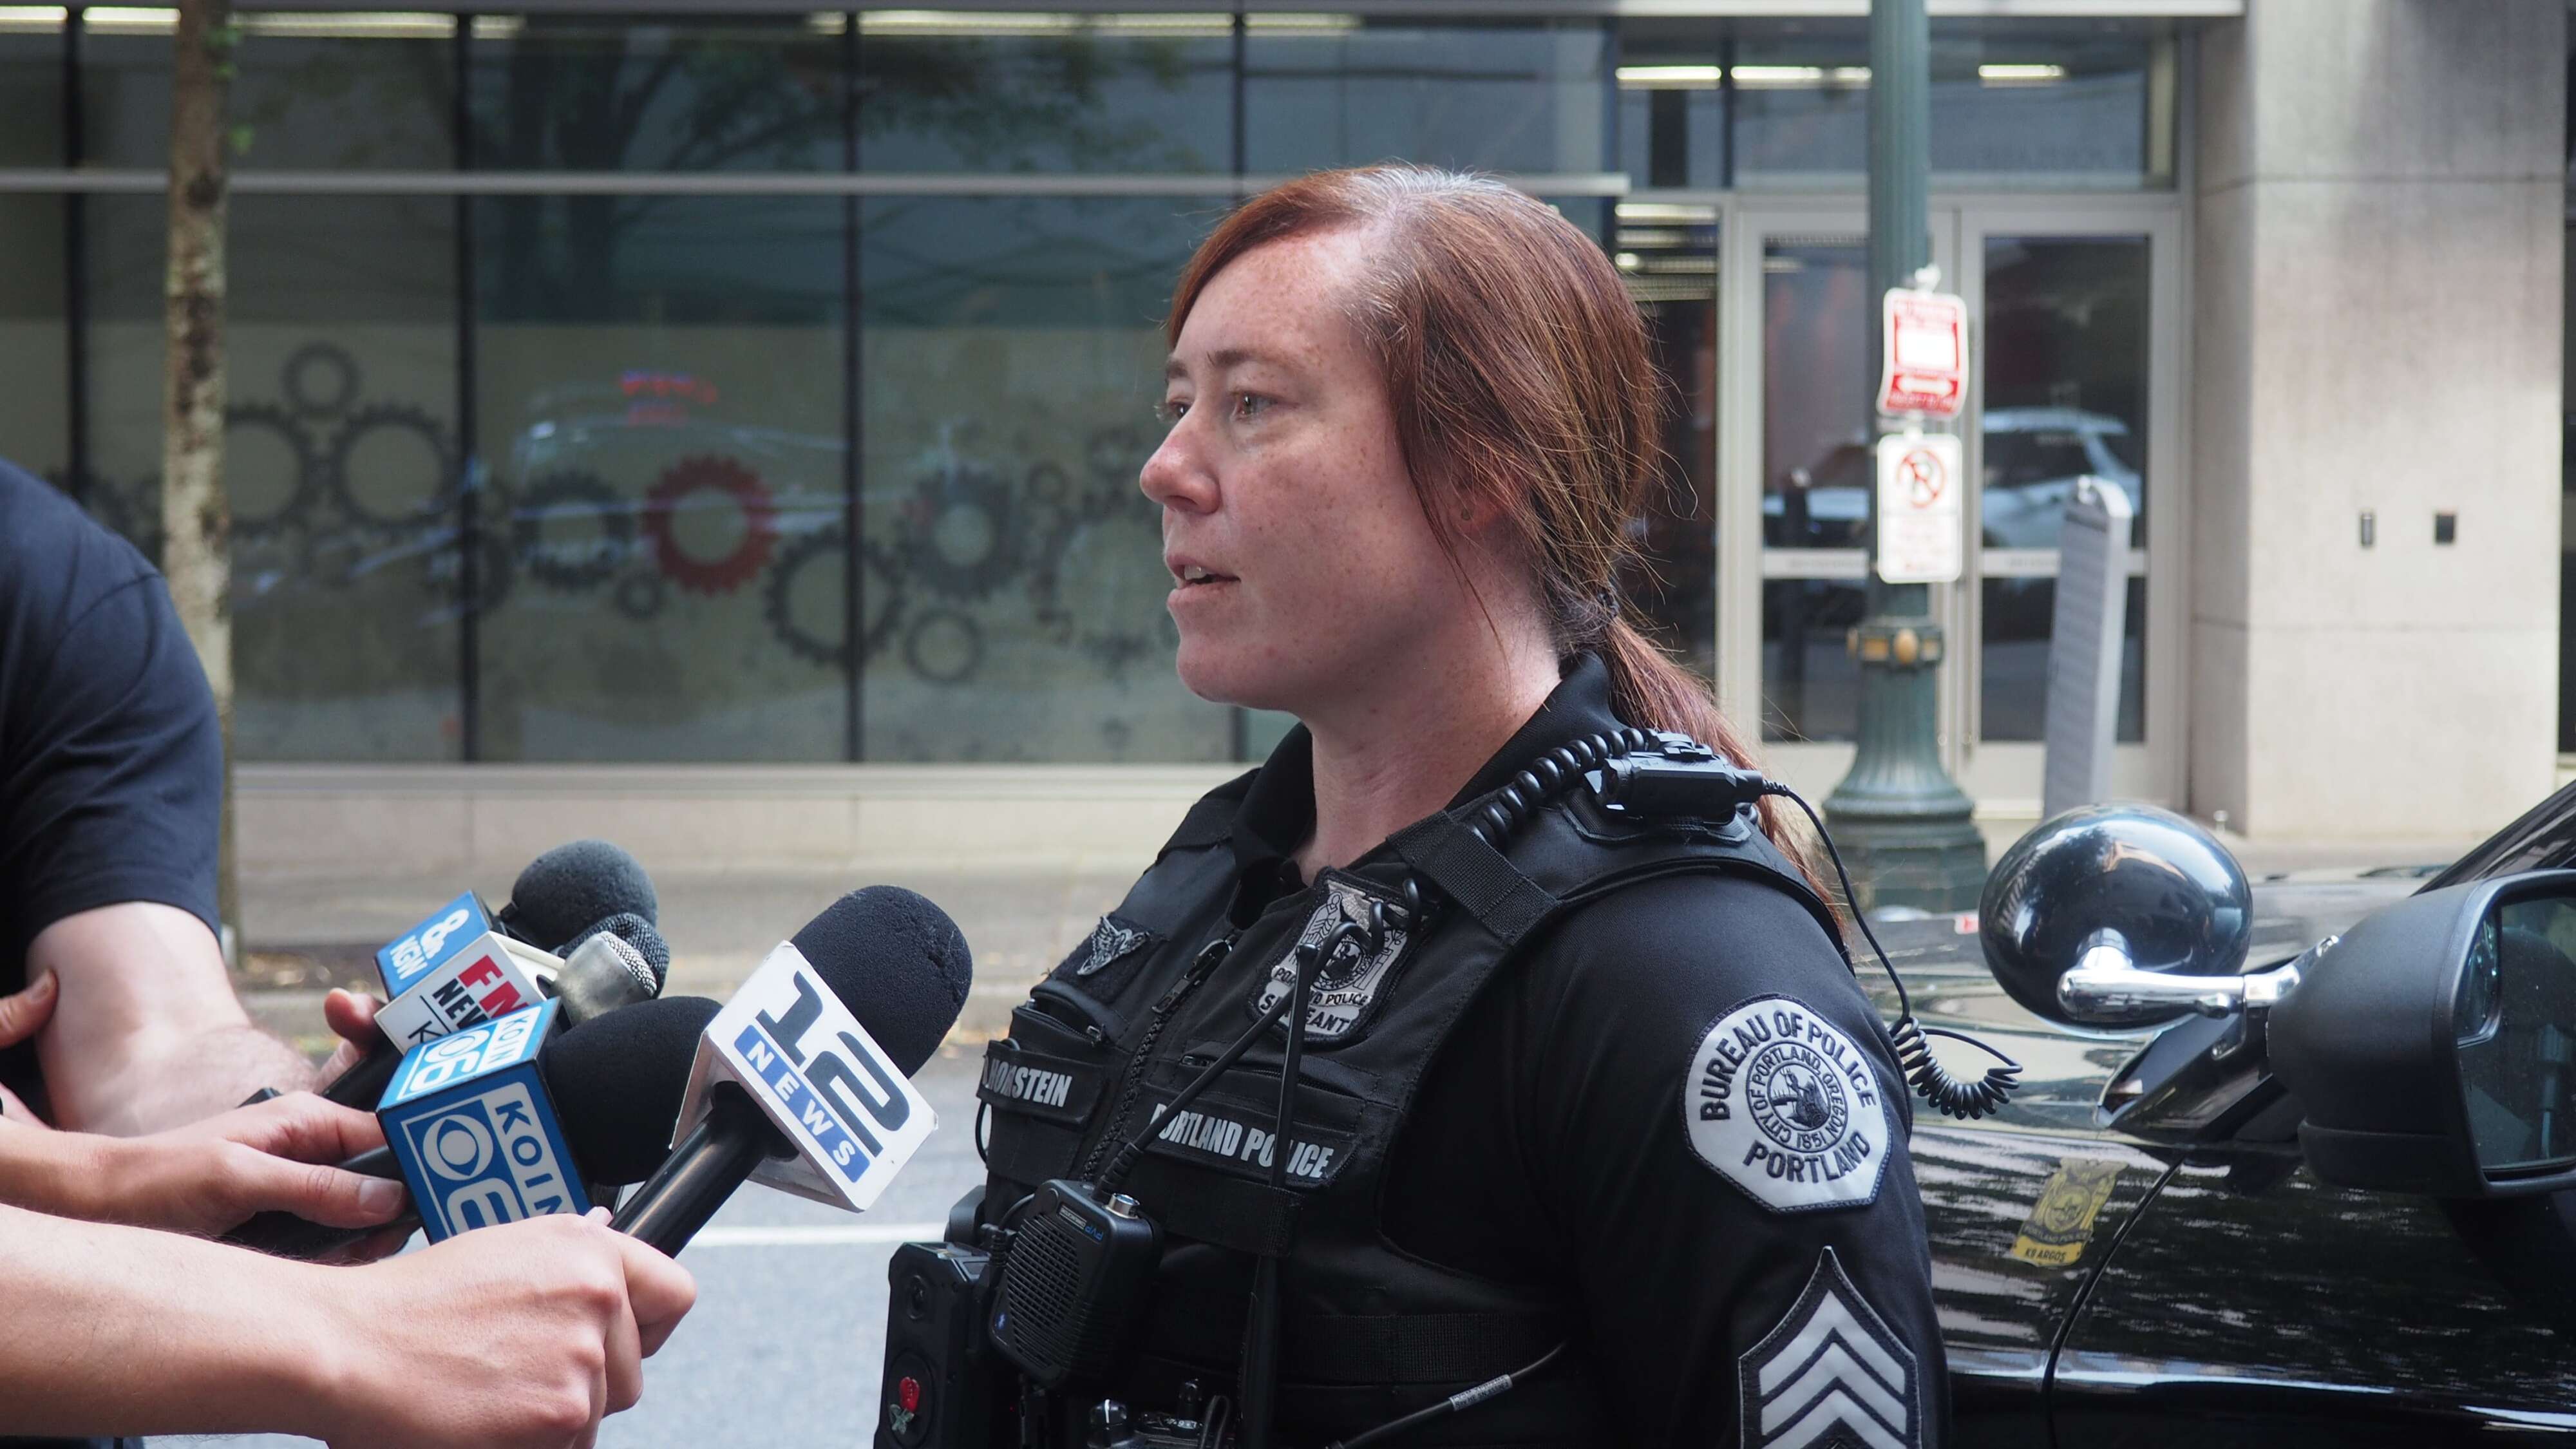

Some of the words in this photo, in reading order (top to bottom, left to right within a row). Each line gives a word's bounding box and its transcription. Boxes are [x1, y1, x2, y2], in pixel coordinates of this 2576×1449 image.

[390, 934, 428, 980] KGW
[1325, 993, 1368, 1005] POLICE
[486, 1014, 529, 1063] KOIN
[755, 971, 910, 1158] 12
[1701, 1014, 1772, 1121] BUREAU
[1774, 1010, 1803, 1038] OF
[1807, 1020, 1877, 1108] POLICE
[1752, 1046, 1821, 1086] PORTLAND,
[747, 1041, 856, 1165] NEWS
[1750, 1089, 1768, 1110] OF
[1823, 1073, 1844, 1139] OREGON
[1759, 1113, 1792, 1142] CITY
[1797, 1131, 1826, 1149] 1851
[1241, 1128, 1334, 1177] POICE
[1743, 1131, 1870, 1183] PORTLAND
[2036, 1250, 2067, 1262] ARGOS
